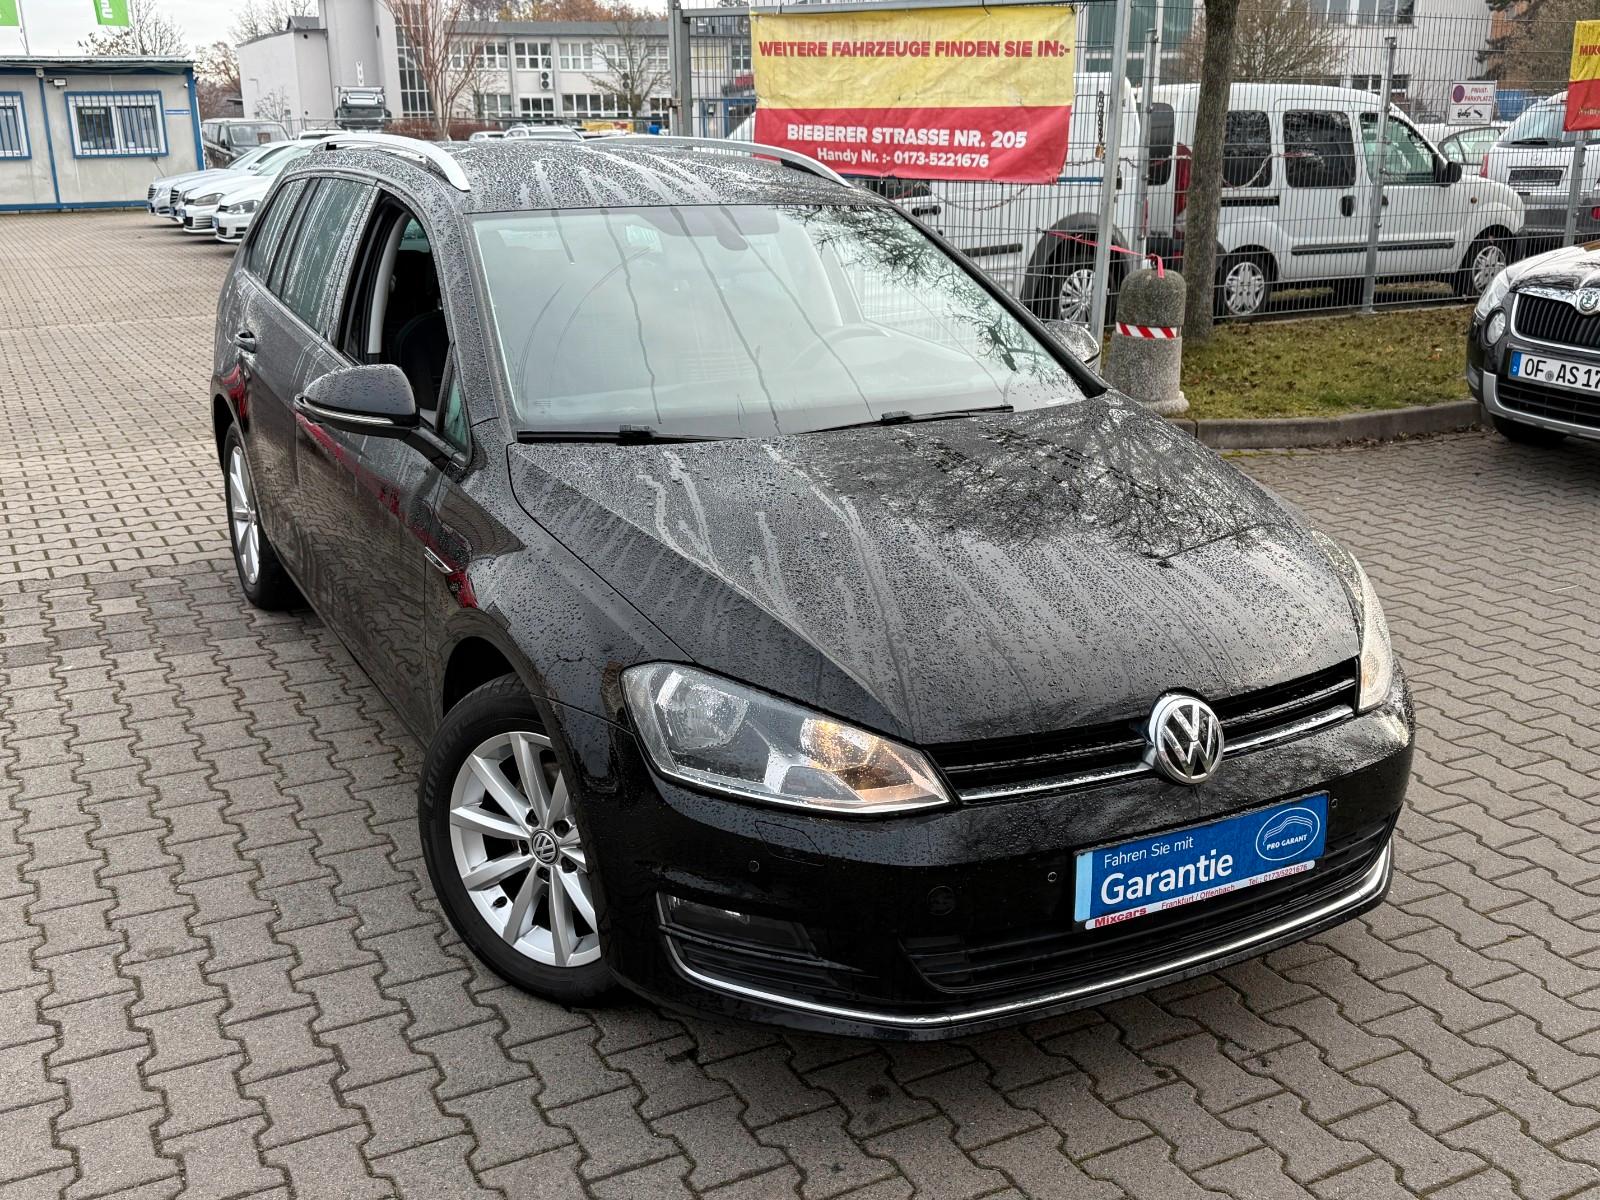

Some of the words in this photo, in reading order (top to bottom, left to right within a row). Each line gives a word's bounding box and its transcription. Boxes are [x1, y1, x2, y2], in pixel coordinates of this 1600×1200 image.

[759, 41, 827, 57] WEITERE
[832, 41, 930, 57] FAHRZEUGE
[935, 41, 1000, 57] FINDEN
[1004, 41, 1033, 57] SIE
[1037, 40, 1070, 57] IN:-
[787, 124, 868, 143] BIEBERER
[872, 127, 950, 146] STRASSE
[953, 130, 985, 147] NR.
[991, 131, 1027, 148] 205
[817, 147, 858, 165] Handy
[861, 149, 879, 163] Nr.
[894, 150, 990, 168] 0173-5221676
[1524, 358, 1547, 377] OF
[1556, 364, 1579, 385] AS
[1104, 850, 1147, 869] Fahren
[1151, 842, 1170, 857] Sie
[1174, 836, 1194, 852] mit
[1266, 841, 1280, 851] PRO
[1281, 834, 1308, 846] GARANT
[1101, 849, 1233, 905] Garantie
[1094, 907, 1147, 928] Mixcars
[1161, 895, 1194, 909] Frankfurt
[1200, 884, 1235, 899] Offenbach
[1263, 864, 1308, 881] 0173/5221676
